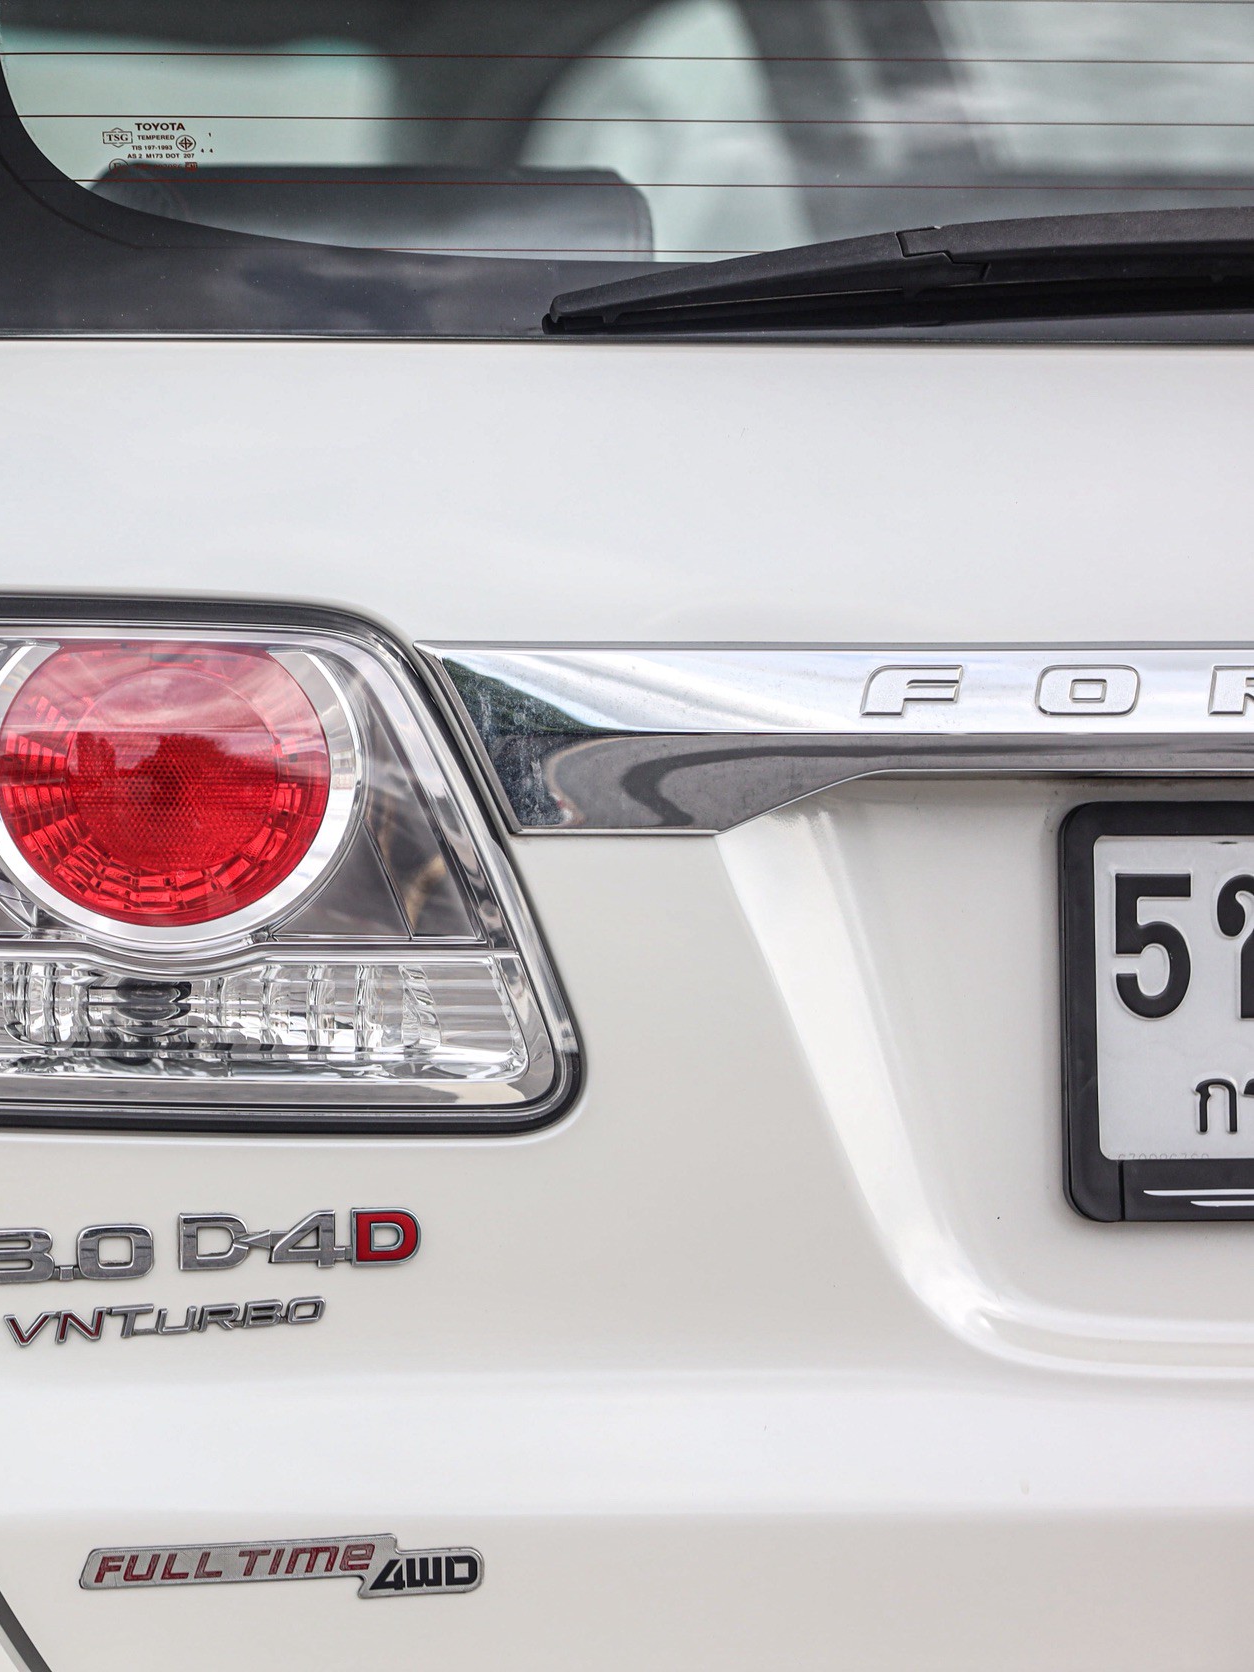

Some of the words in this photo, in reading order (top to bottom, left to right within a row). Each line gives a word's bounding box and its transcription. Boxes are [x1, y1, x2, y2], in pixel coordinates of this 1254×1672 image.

[135, 122, 186, 131] TOYOTA
[106, 133, 129, 142] TSG
[369, 1555, 479, 1592] 4WD
